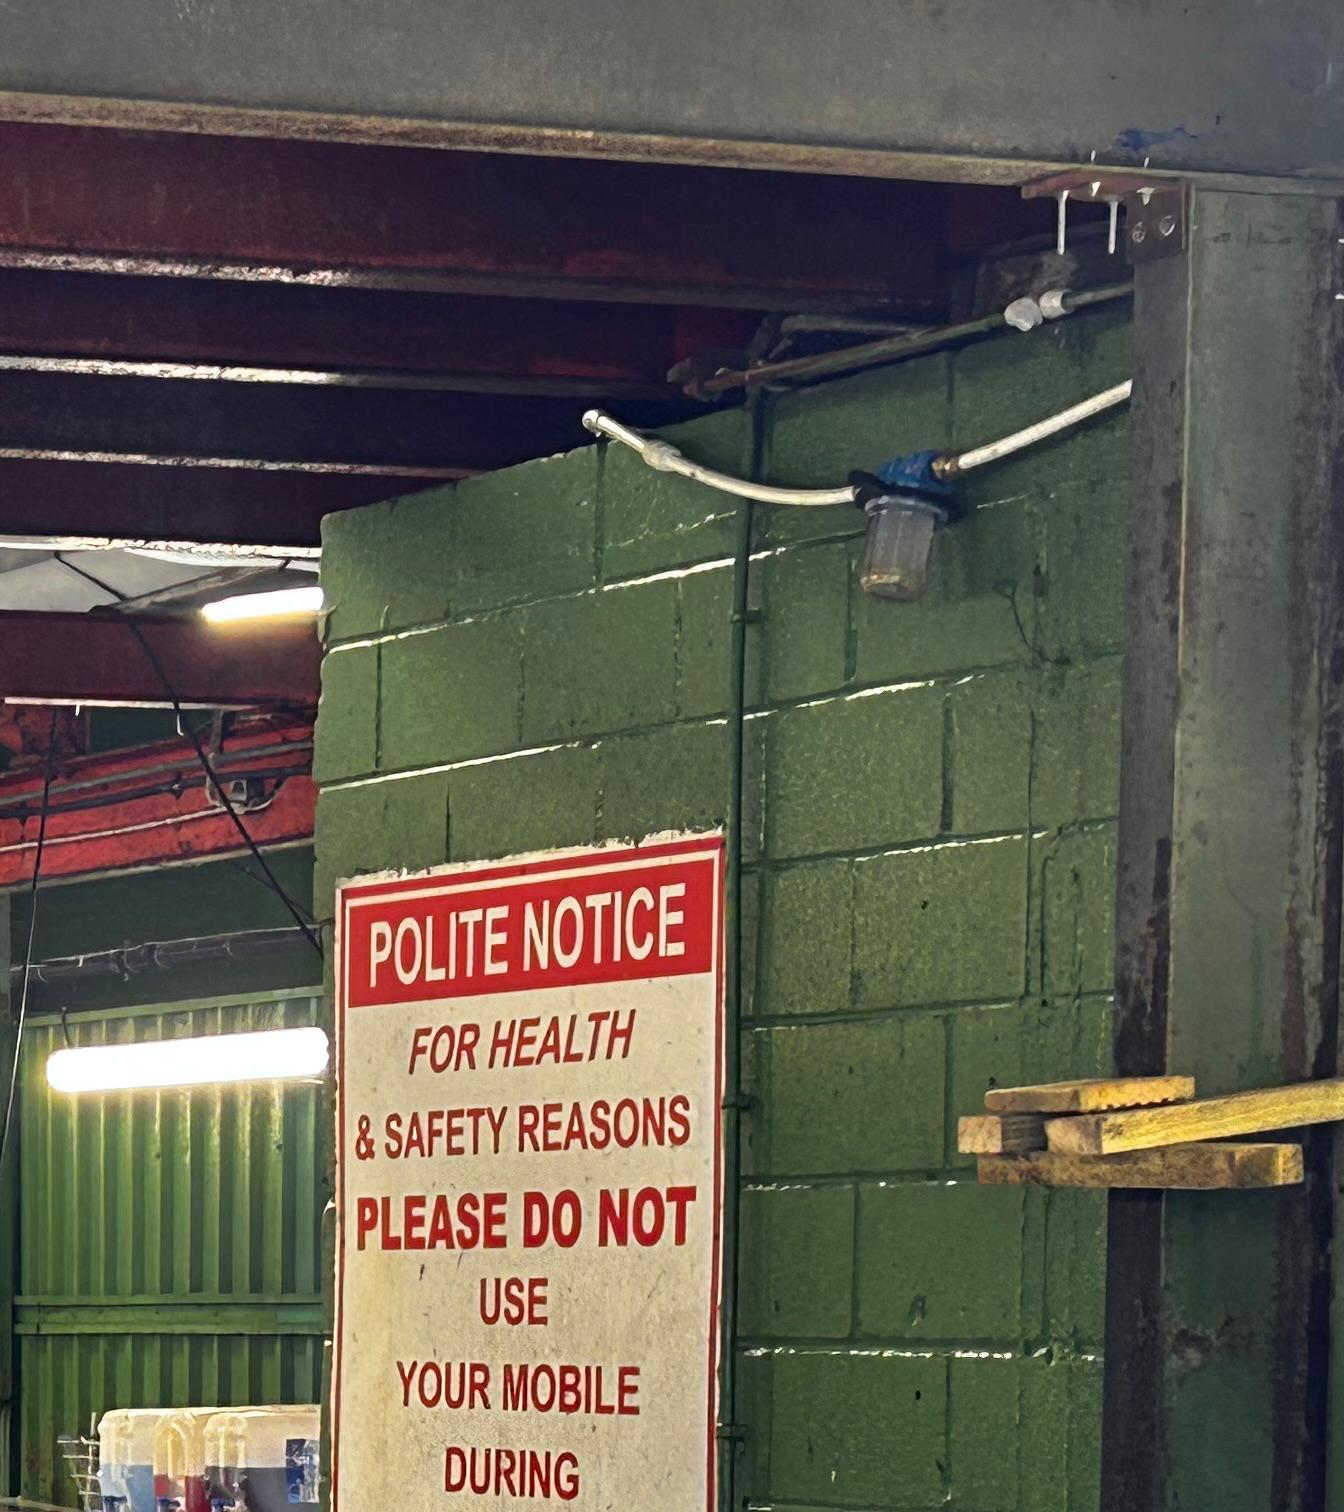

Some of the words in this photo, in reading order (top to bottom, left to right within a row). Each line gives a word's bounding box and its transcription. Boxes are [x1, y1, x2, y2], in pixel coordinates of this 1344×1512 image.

[369, 905, 509, 988] POLITE
[522, 882, 686, 971] NOTICE
[408, 1024, 480, 1075] FOR
[488, 1008, 637, 1069] HEALTH
[355, 1114, 376, 1160] &
[384, 1106, 508, 1159] SAFETY
[518, 1095, 691, 1153] REASONS
[357, 1192, 509, 1251] PLEASE
[523, 1189, 582, 1248] DO
[598, 1186, 697, 1247] NOT
[479, 1277, 549, 1326] USE
[396, 1360, 491, 1410] YOUR
[503, 1363, 640, 1415] MOBILE
[444, 1446, 579, 1500] DURING
